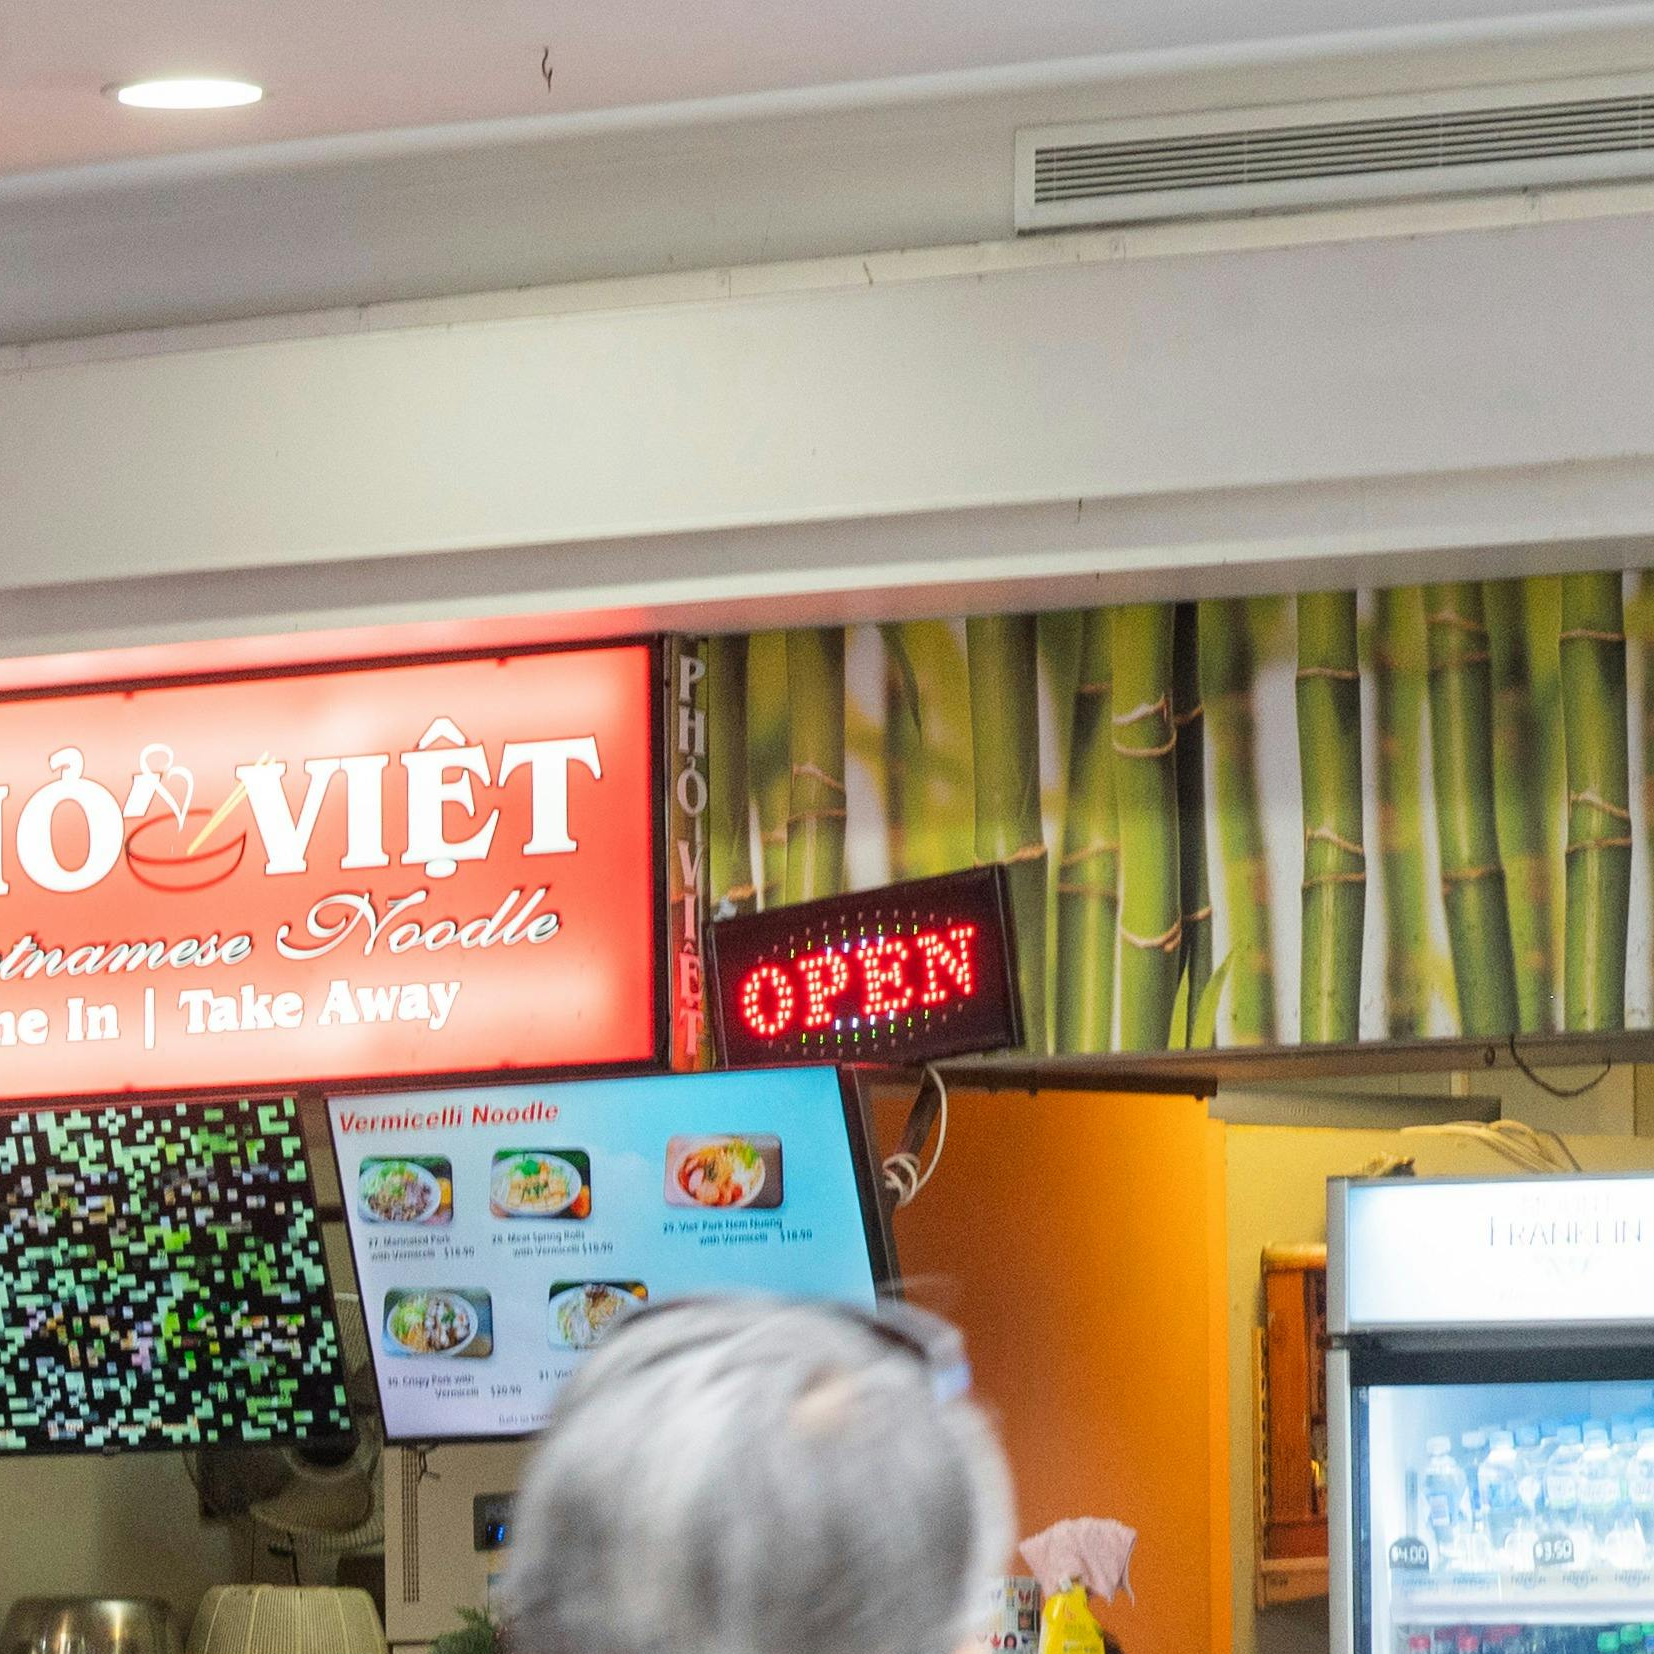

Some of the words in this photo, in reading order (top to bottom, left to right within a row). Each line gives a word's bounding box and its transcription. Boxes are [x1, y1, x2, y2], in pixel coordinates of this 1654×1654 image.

[233, 717, 605, 878] VIỆT
[277, 888, 560, 962] Noodle
[64, 1000, 119, 1041] In
[178, 990, 301, 1035] Take
[317, 979, 461, 1032] Away
[741, 922, 975, 1036] OPEN
[339, 1105, 464, 1136] Vermicelli
[472, 1100, 560, 1126] Noodle
